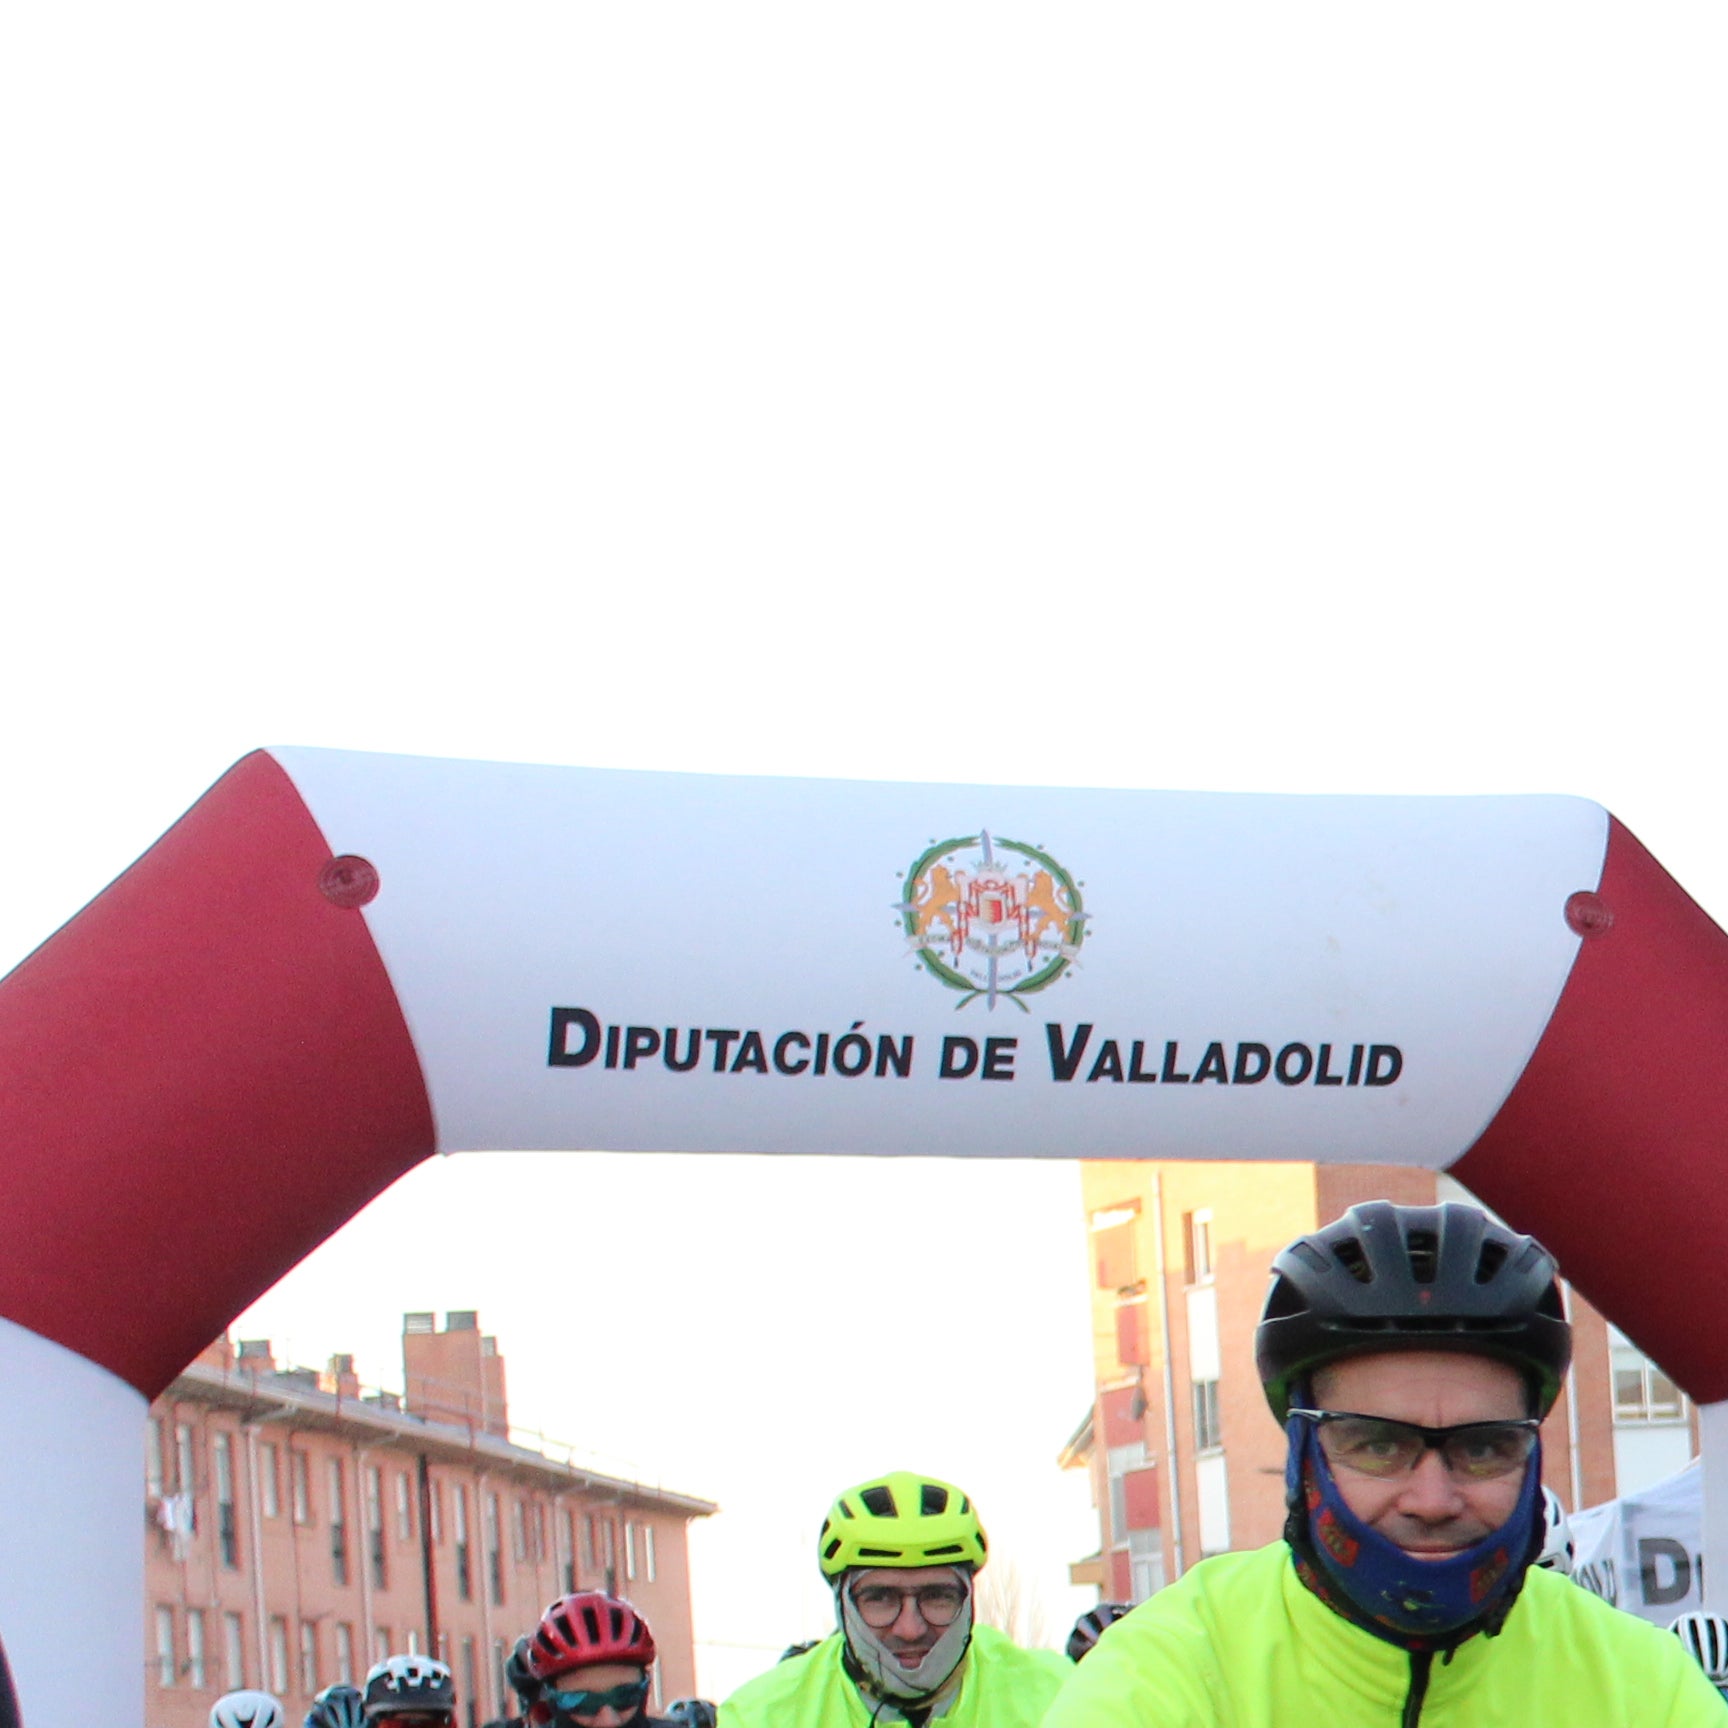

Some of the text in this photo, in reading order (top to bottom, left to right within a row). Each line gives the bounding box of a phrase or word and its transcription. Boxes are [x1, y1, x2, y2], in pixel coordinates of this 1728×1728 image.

[546, 1006, 1404, 1087] DIPUTACIÓN DE VALLADOLID
